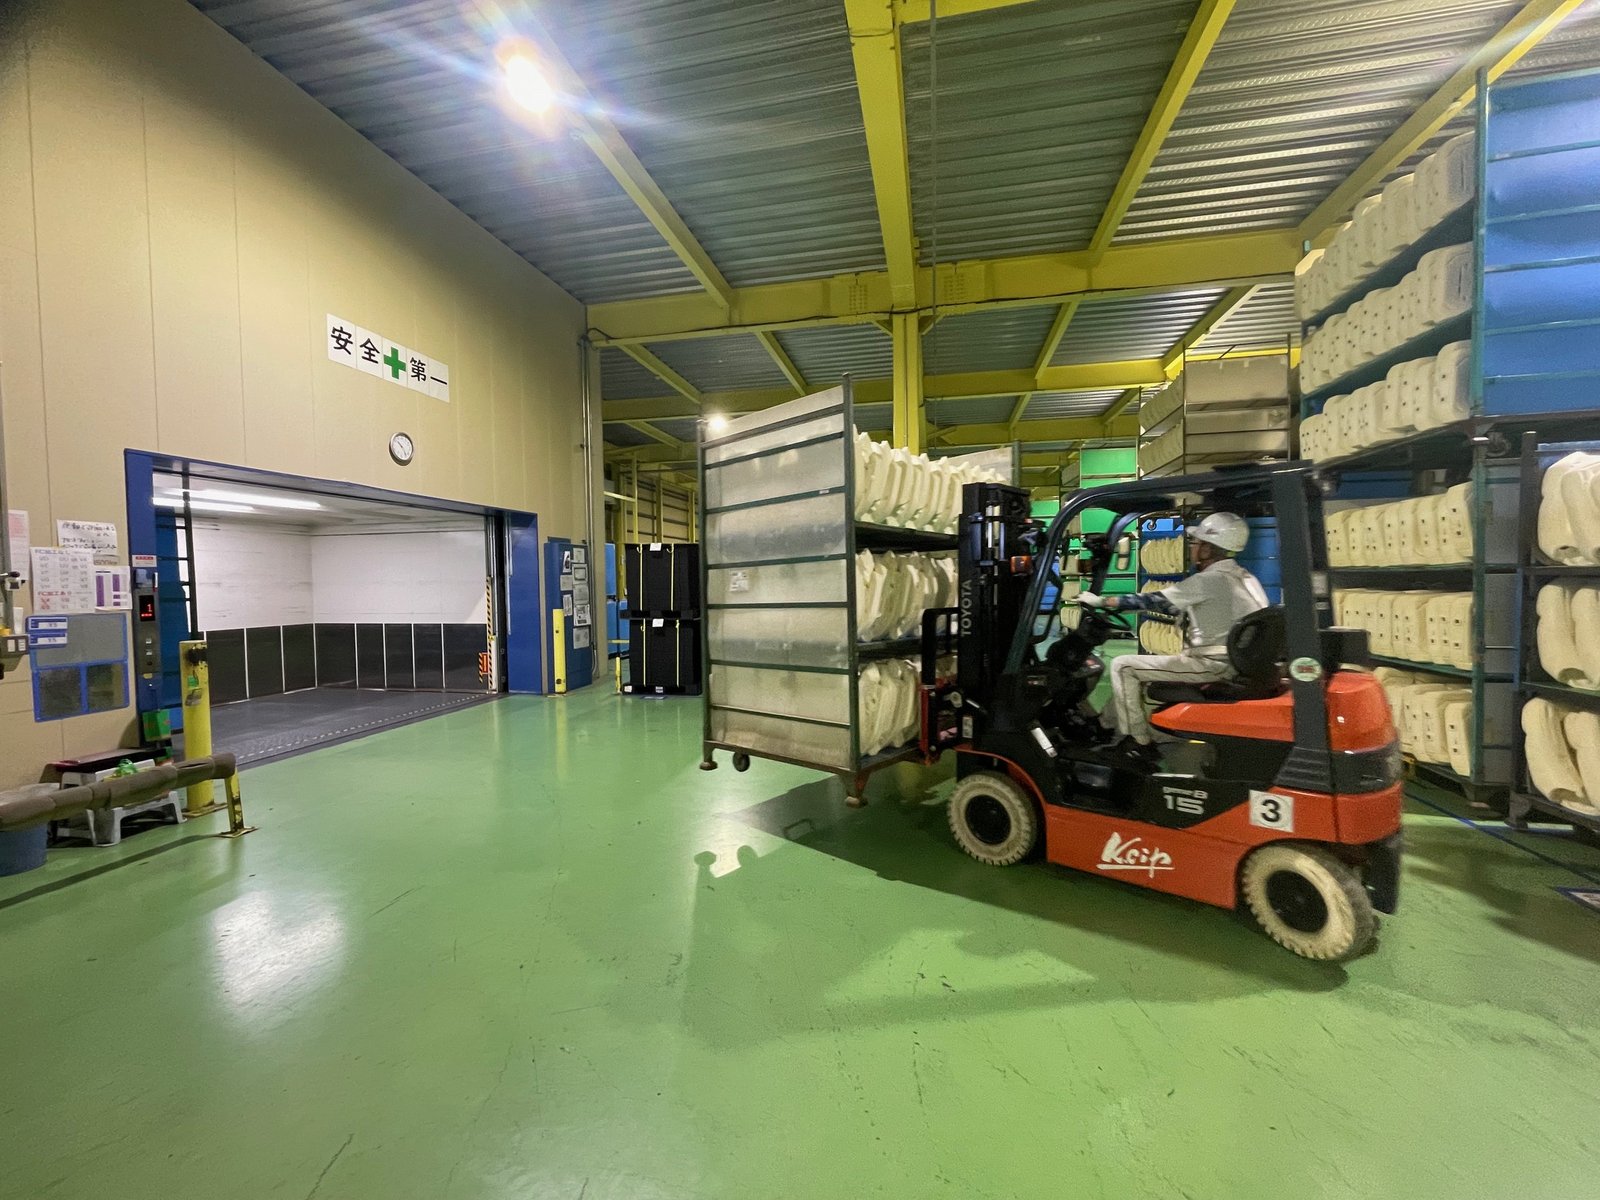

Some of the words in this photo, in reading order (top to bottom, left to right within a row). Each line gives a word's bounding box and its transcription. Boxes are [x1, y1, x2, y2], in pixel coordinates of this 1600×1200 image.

[960, 579, 973, 637] TOYOTA
[1163, 794, 1205, 815] 15
[1261, 799, 1281, 823] 3
